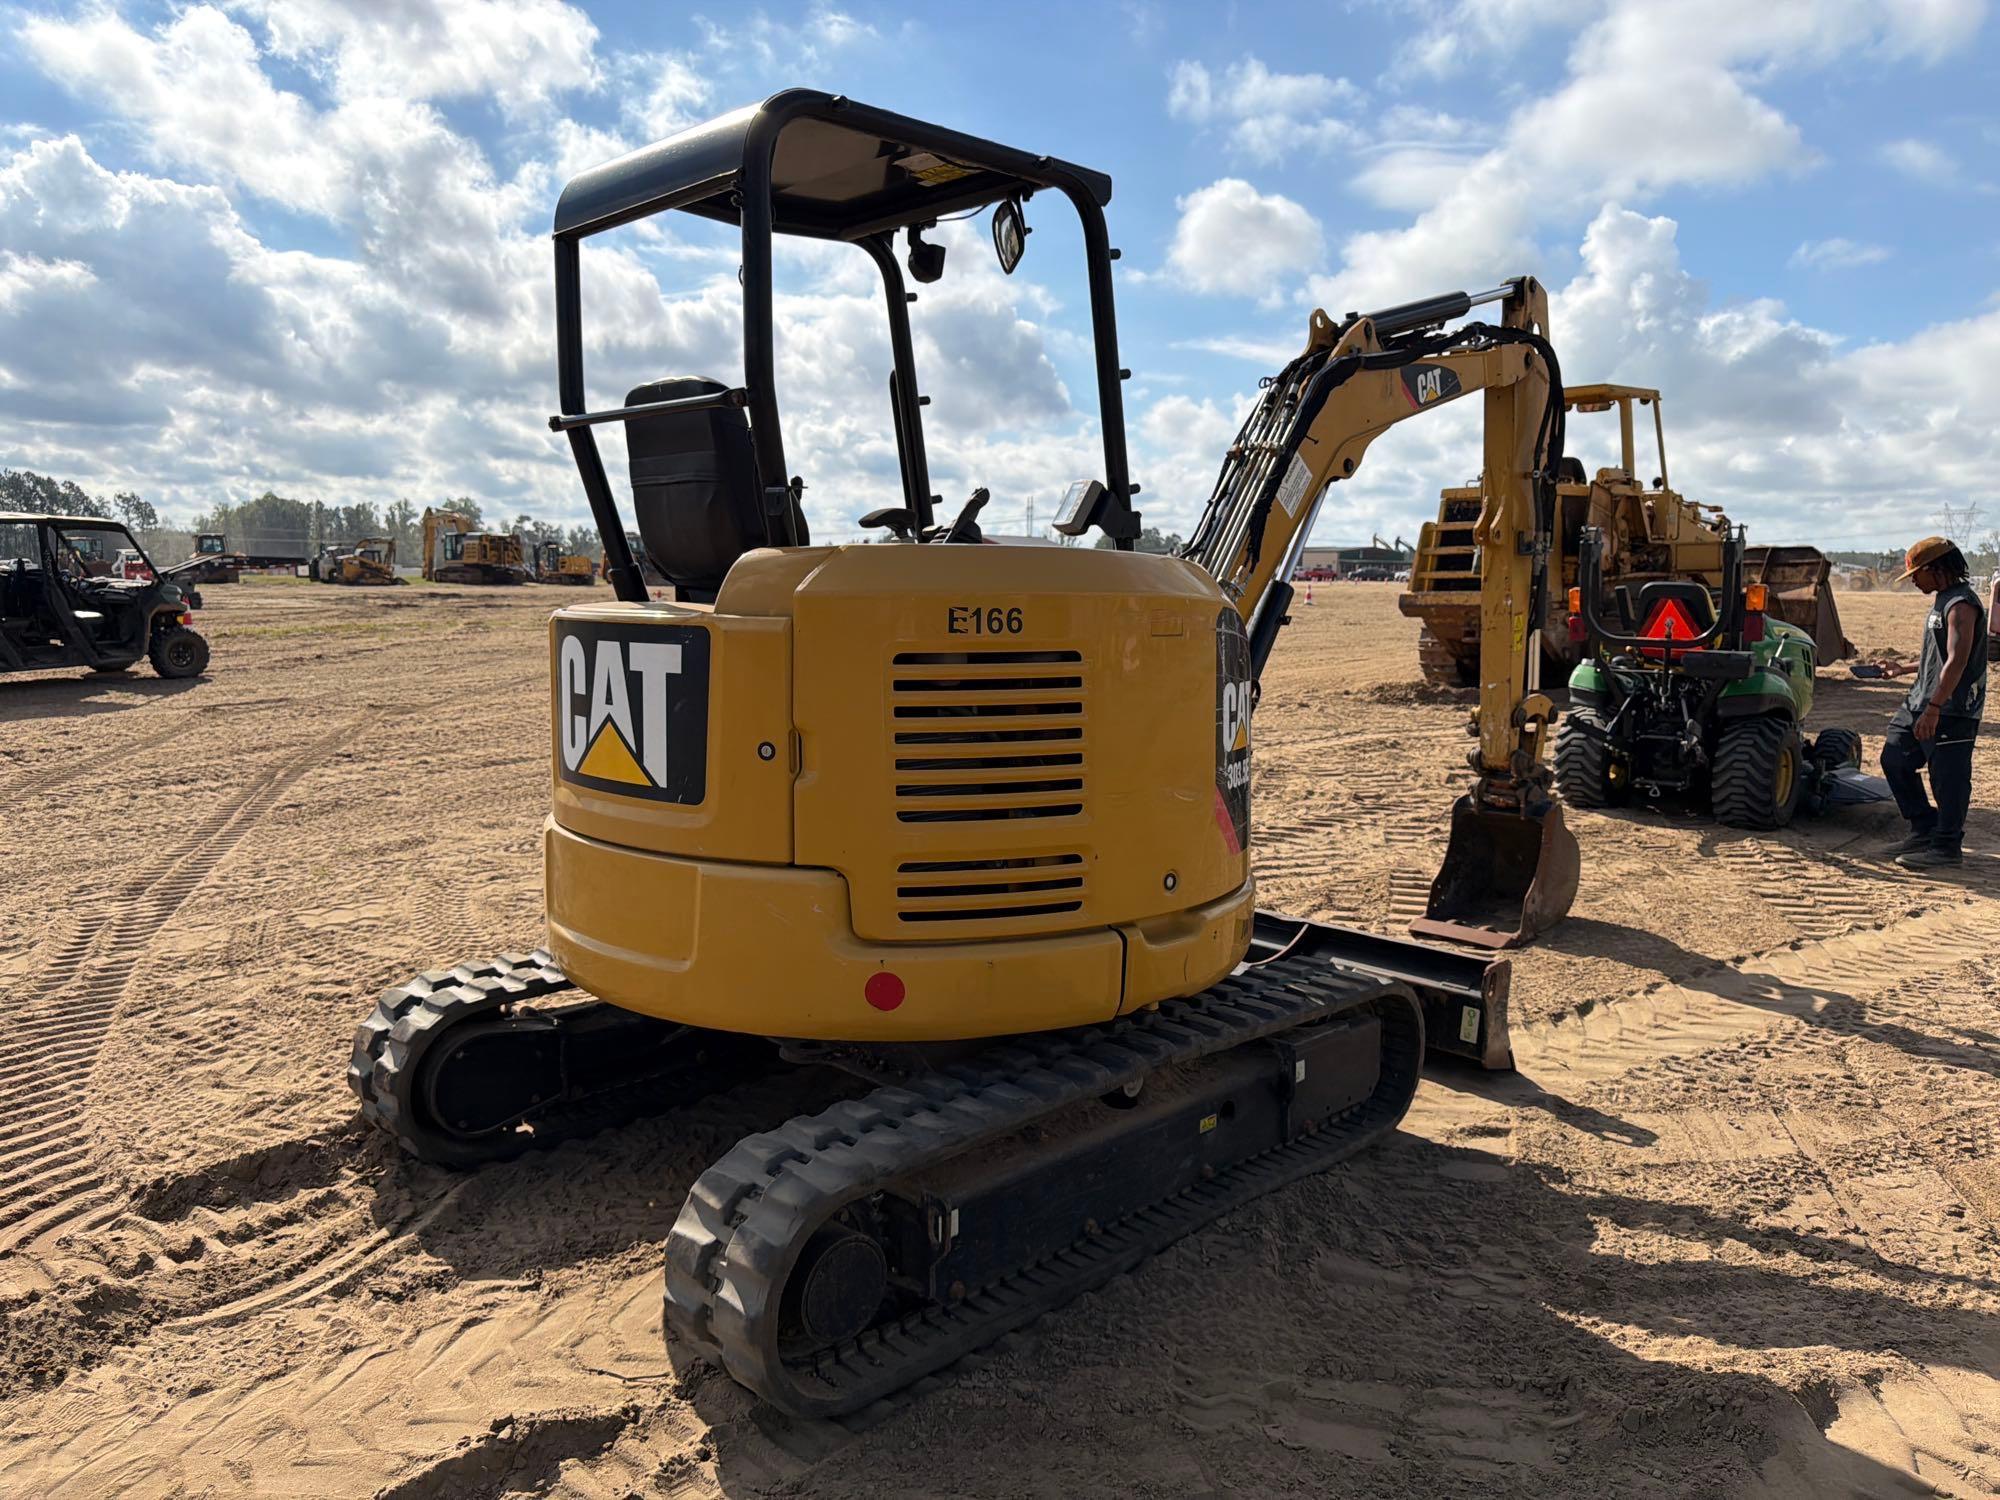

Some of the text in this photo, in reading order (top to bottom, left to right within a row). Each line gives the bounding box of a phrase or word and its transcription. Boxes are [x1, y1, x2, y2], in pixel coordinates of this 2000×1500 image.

[1417, 368, 1441, 404] CAT
[948, 607, 1023, 634] E166
[561, 634, 683, 789] CAT
[1223, 681, 1251, 752] CAT
